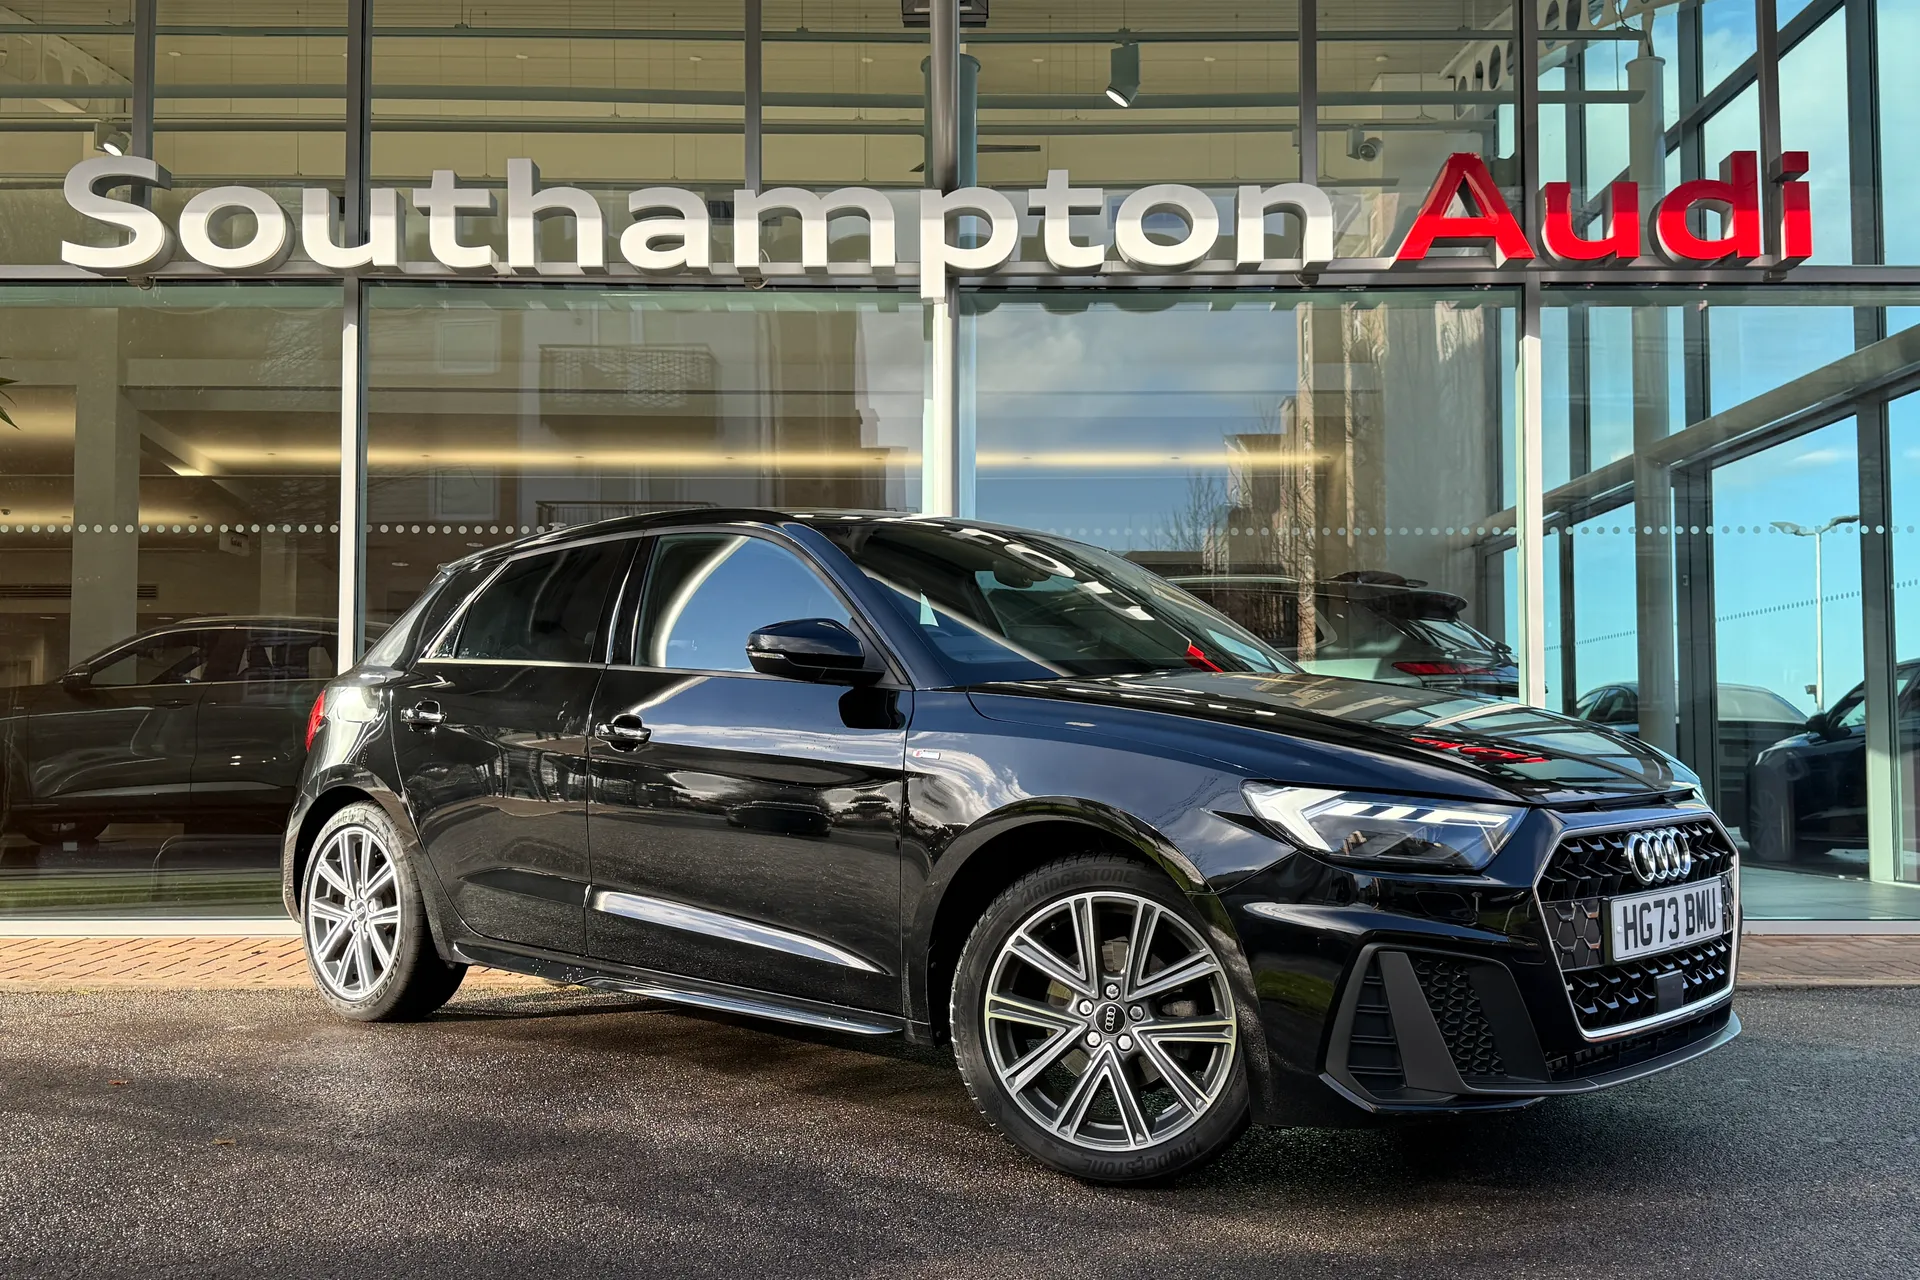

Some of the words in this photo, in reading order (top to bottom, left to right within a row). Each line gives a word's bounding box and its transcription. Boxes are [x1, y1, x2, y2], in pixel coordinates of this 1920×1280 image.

[62, 156, 1334, 299] Southampton
[1396, 150, 1813, 261] Audi
[1021, 868, 1133, 906] BRIDGESTONE
[1622, 896, 1680, 951] HG73
[1684, 887, 1717, 937] BMU
